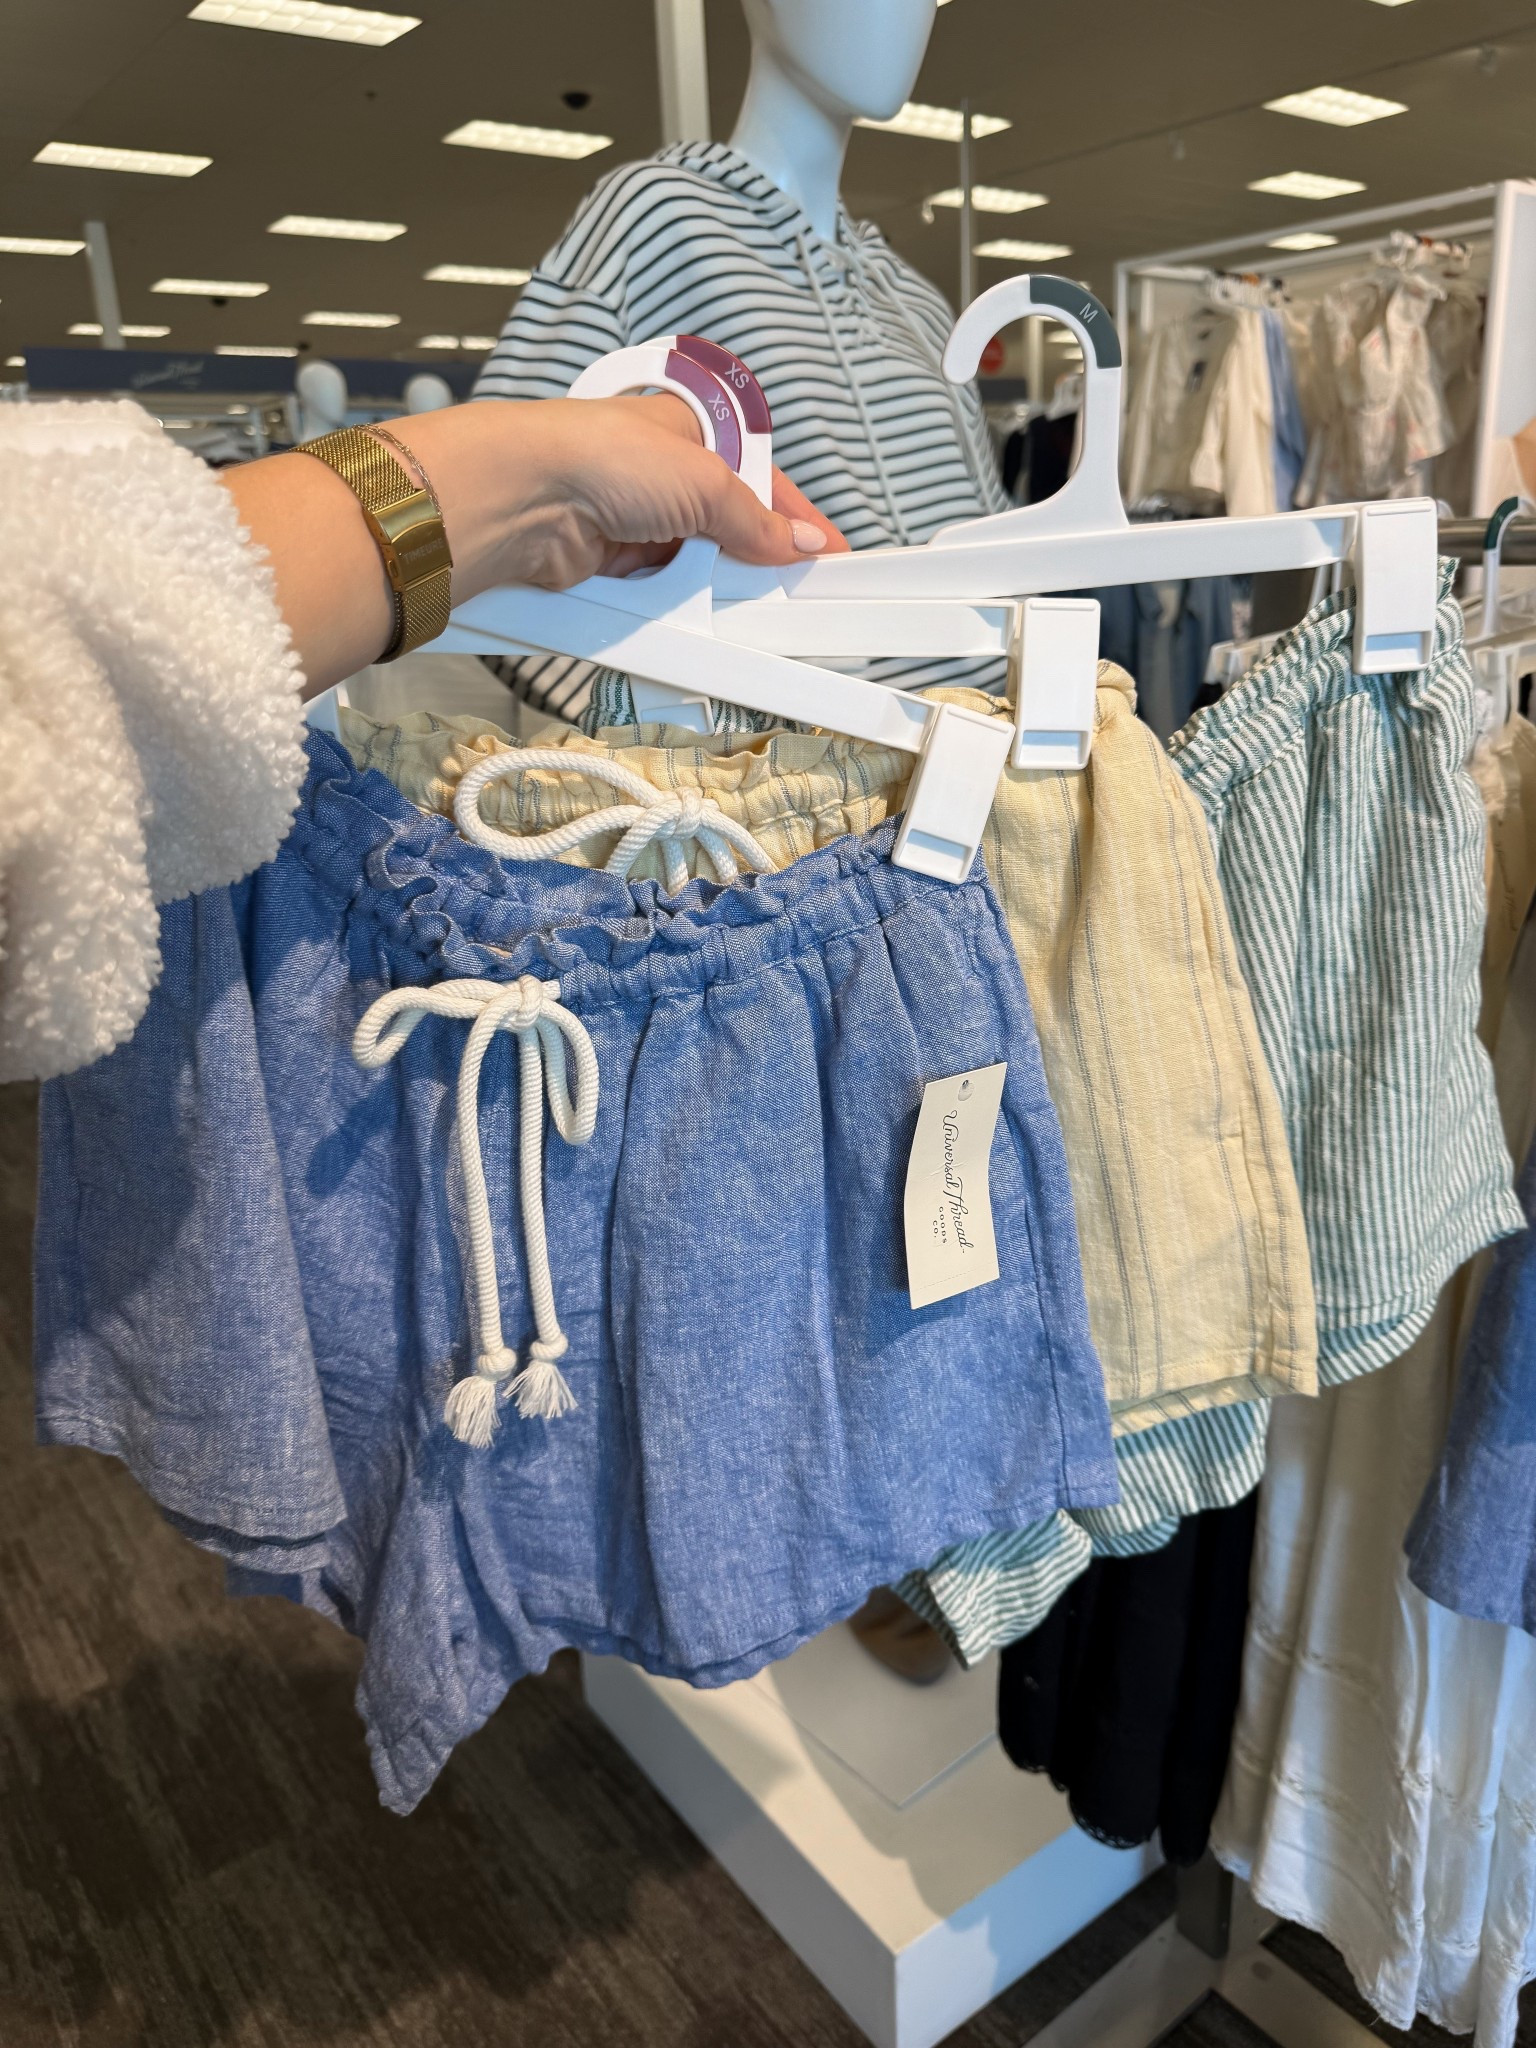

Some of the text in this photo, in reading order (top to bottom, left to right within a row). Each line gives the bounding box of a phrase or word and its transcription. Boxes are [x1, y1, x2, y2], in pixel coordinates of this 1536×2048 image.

[1079, 302, 1099, 324] M
[724, 362, 750, 390] XS
[707, 393, 731, 422] XS
[942, 1109, 975, 1249] Universal Thread
[939, 1206, 948, 1244] GOODS
